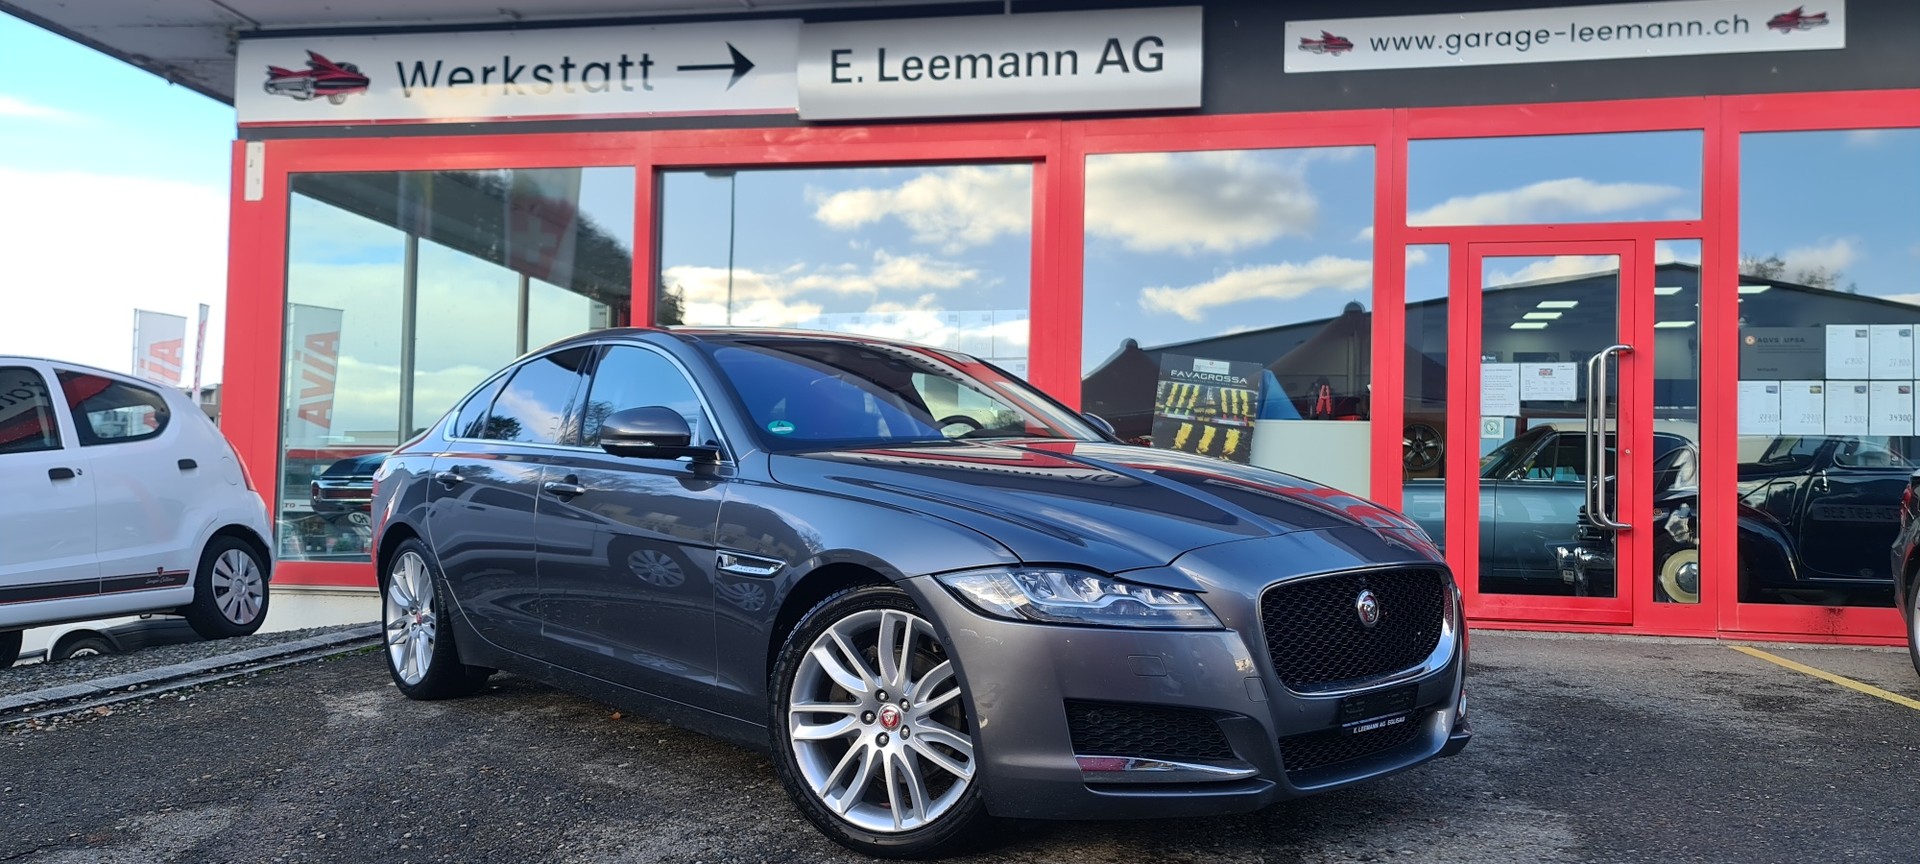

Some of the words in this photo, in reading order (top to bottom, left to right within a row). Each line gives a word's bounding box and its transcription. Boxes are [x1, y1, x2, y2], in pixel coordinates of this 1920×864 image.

[1370, 14, 1750, 54] www.garage-leemann.ch
[395, 53, 655, 98] Werkstatt
[830, 48, 863, 84] E.
[877, 47, 1079, 83] Leemann
[1094, 35, 1165, 74] AG
[296, 330, 339, 430] AVIA
[1170, 369, 1248, 385] FAVAGROSSA
[352, 513, 369, 524] CH
